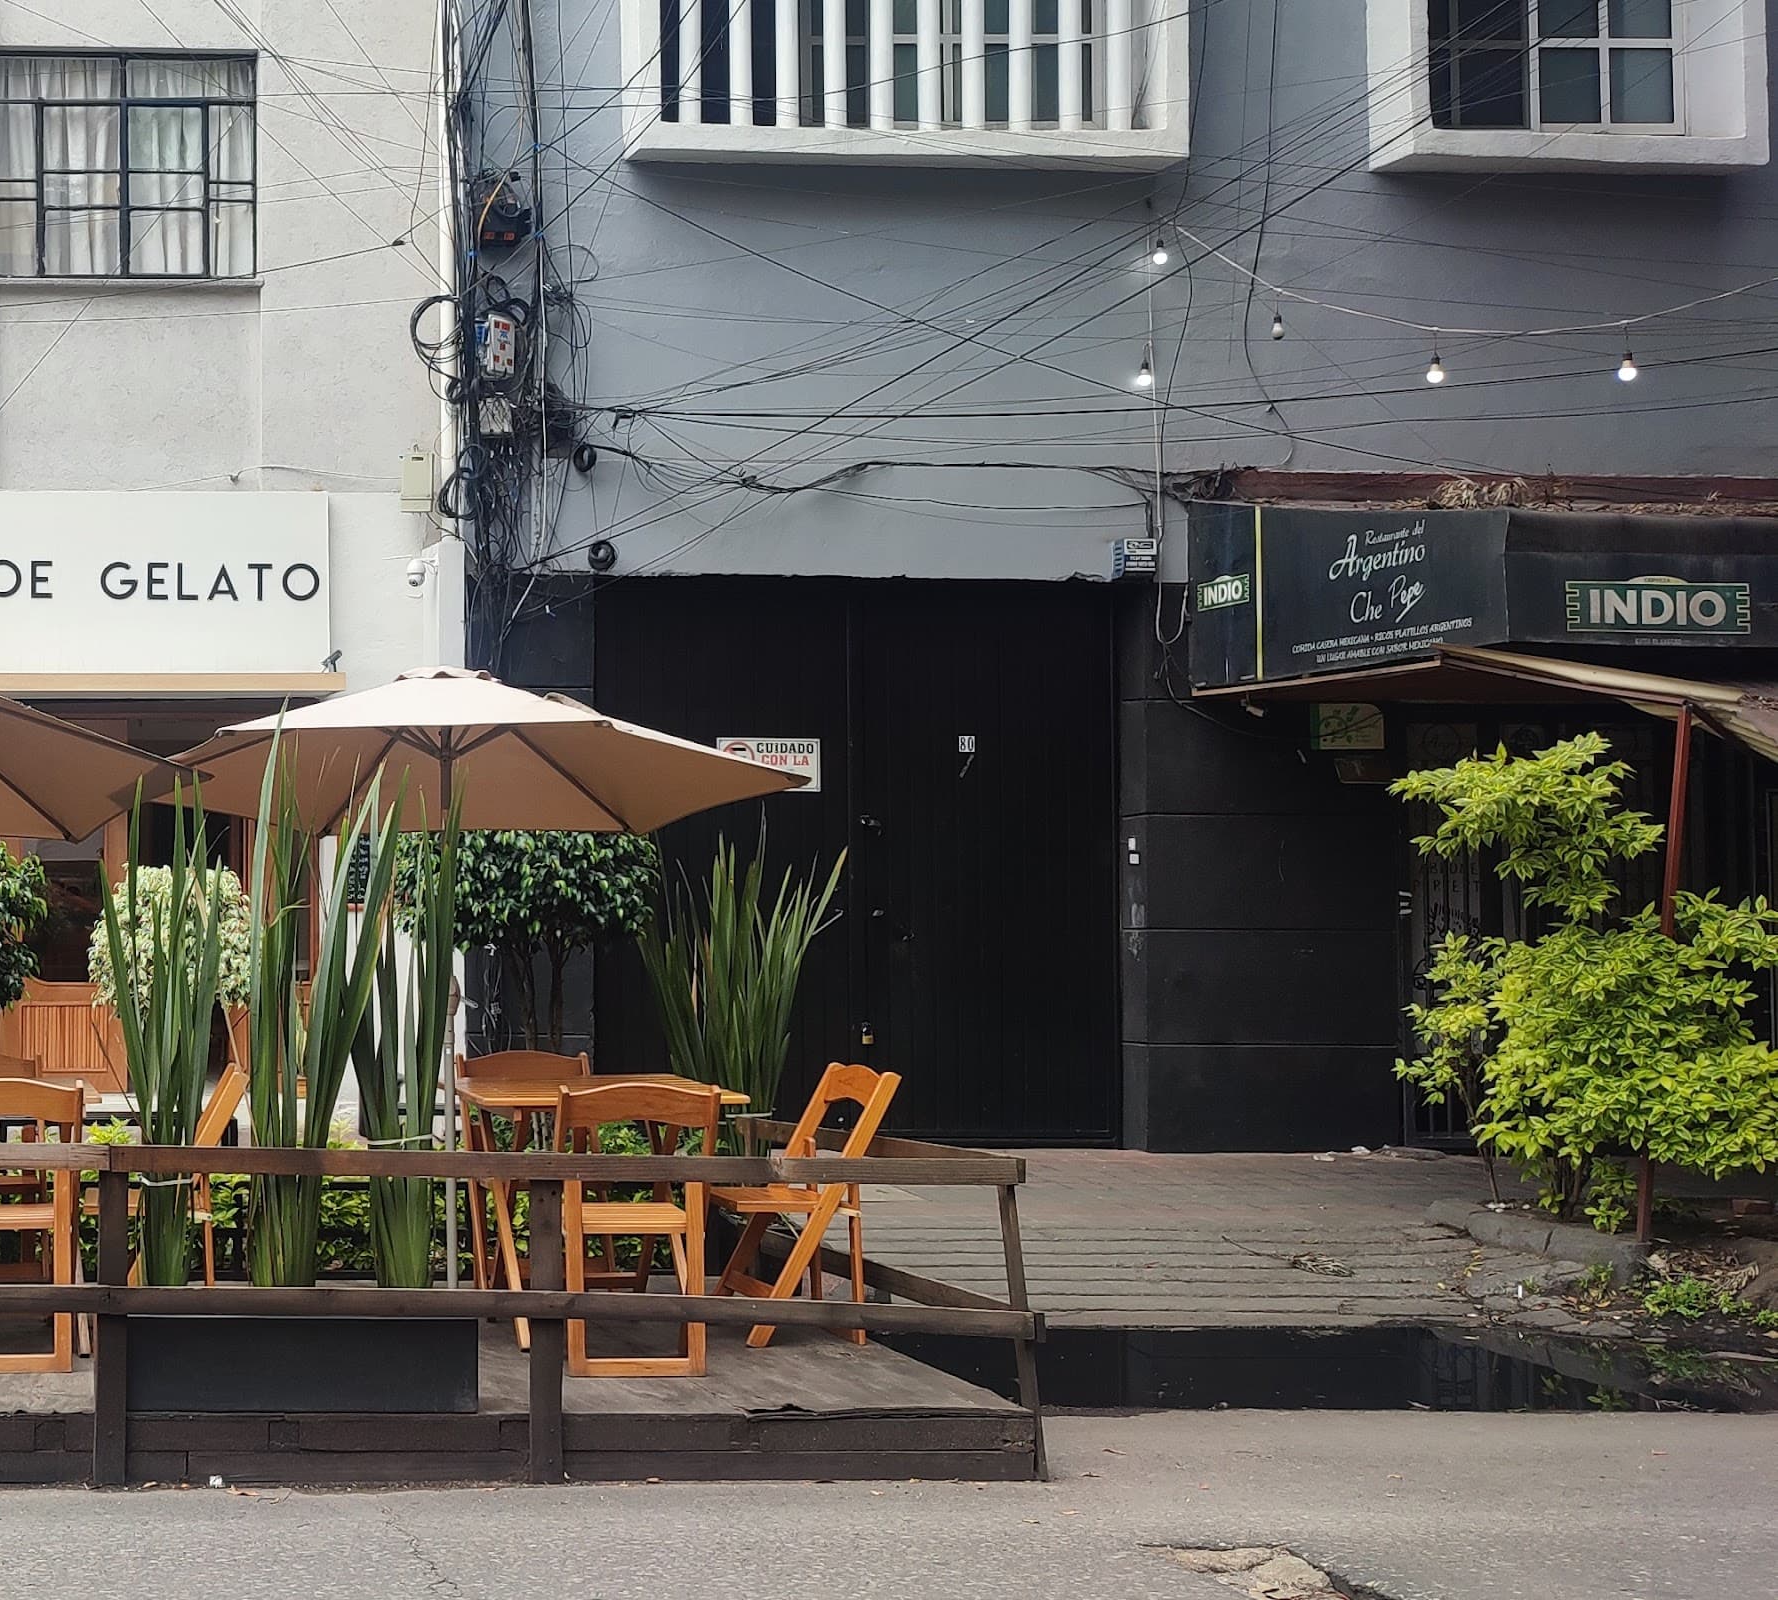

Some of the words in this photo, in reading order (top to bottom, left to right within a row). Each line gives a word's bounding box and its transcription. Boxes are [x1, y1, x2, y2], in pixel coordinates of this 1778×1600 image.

[1412, 519, 1426, 536] del
[1329, 534, 1426, 581] Argentino
[100, 561, 321, 601] GELATO
[1203, 580, 1242, 607] INDIO
[1350, 591, 1383, 623] Che
[1388, 574, 1427, 623] Pepe
[1589, 589, 1727, 627] INDIO
[1339, 634, 1370, 647] MEXICANA
[1374, 630, 1394, 642] RICOS
[1394, 624, 1430, 639] PLATILLOS
[1429, 617, 1473, 634] ARGENTINOS
[756, 742, 814, 754] CUIDADO
[960, 736, 974, 751] 80
[762, 755, 787, 766] CON
[793, 755, 809, 766] LA
